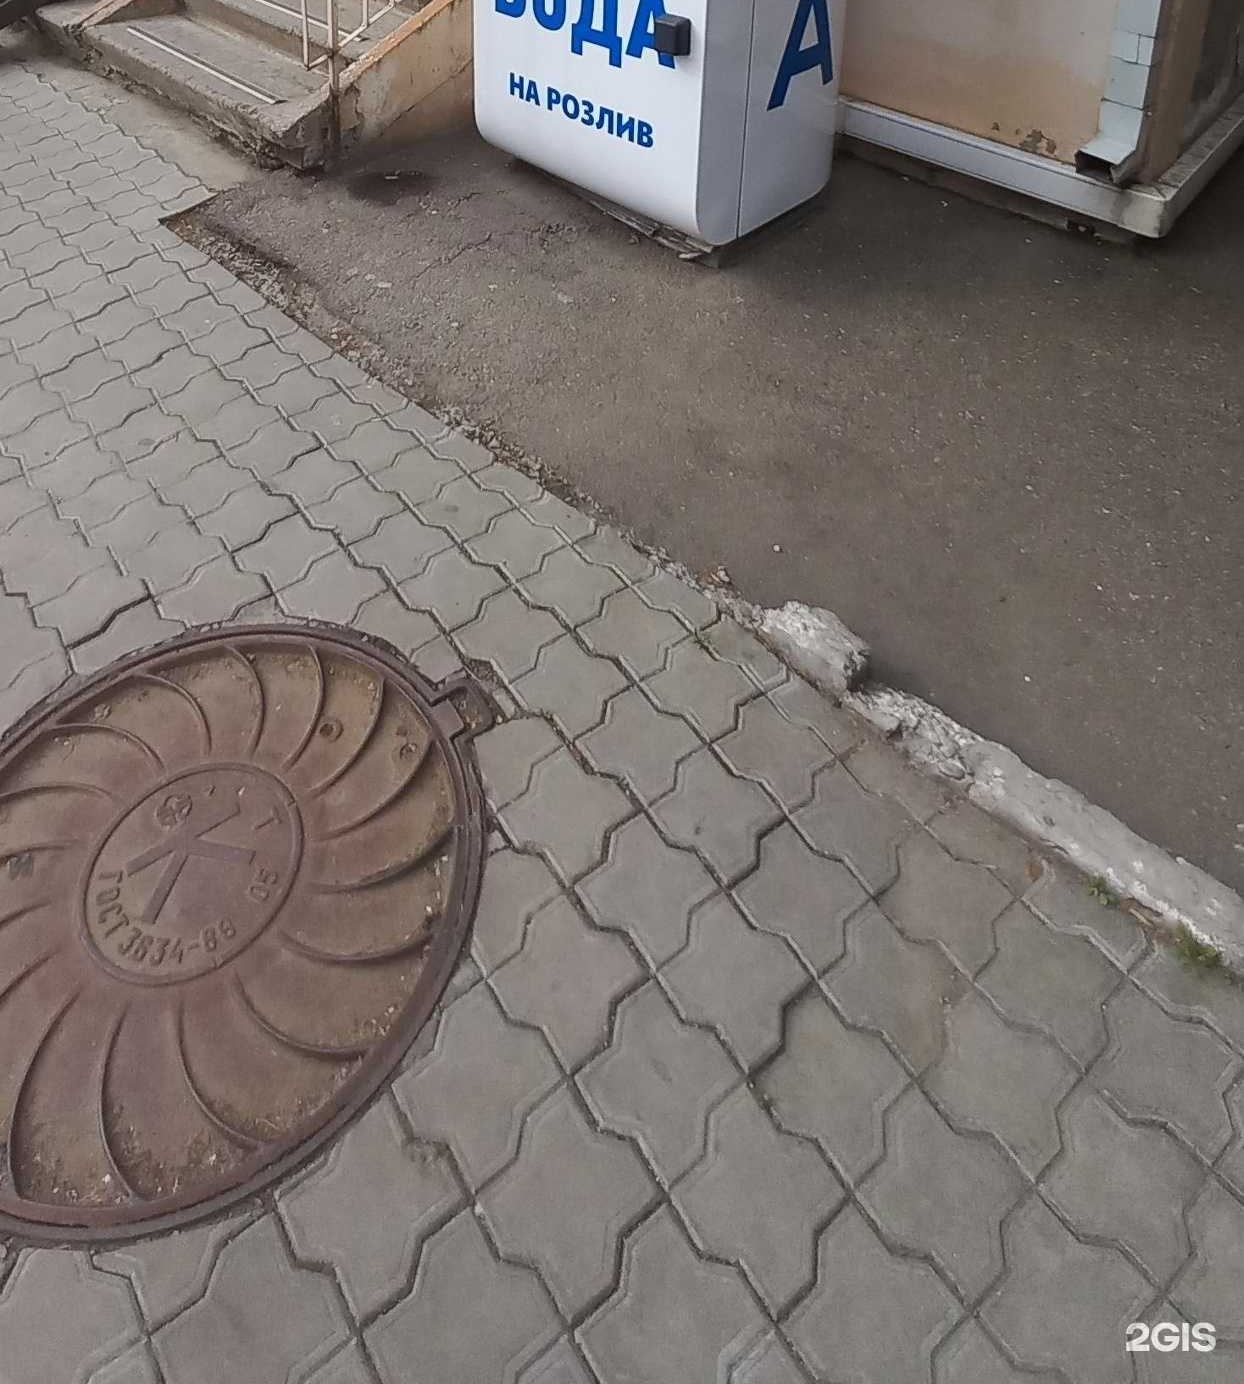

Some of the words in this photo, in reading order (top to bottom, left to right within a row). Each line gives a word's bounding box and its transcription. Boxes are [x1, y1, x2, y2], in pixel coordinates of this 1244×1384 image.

[510, 72, 540, 106] НА
[547, 86, 654, 148] РОЗЛИВ
[95, 869, 131, 938] ГОСТ
